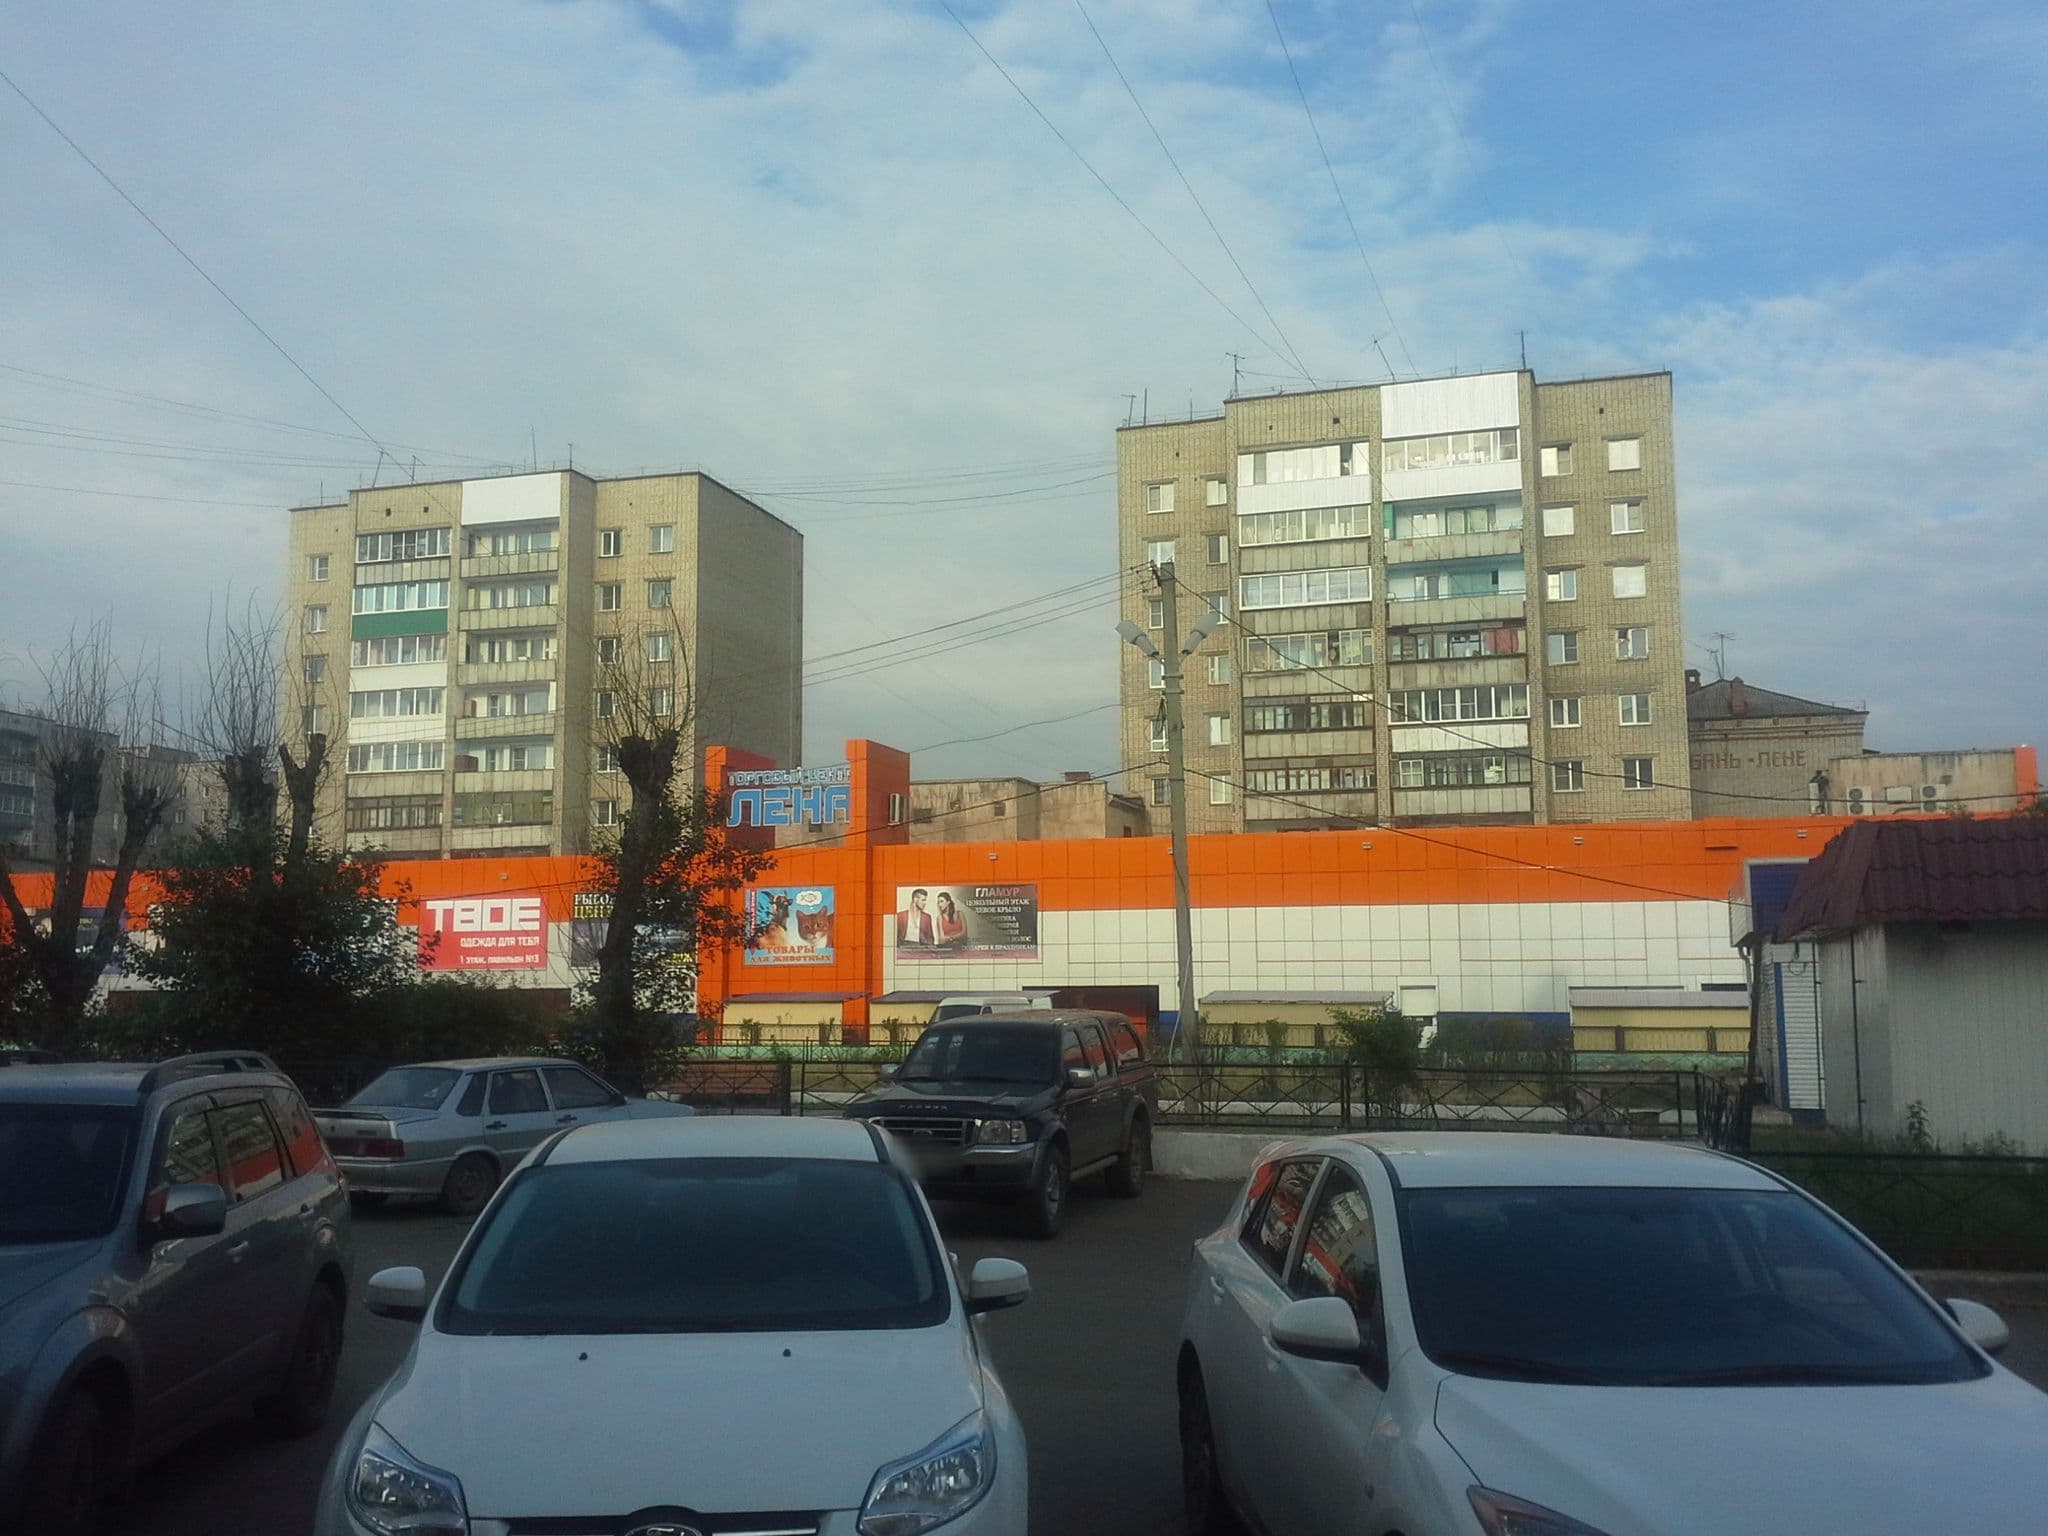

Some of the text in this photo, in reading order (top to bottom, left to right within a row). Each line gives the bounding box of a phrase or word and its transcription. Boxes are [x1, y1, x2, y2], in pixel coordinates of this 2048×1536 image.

[728, 766, 803, 786] ТОРГОВЫЙ
[727, 784, 851, 828] ЛЕНА
[975, 887, 1021, 898] ГЛАМУР
[426, 897, 541, 933] ТВОЕ
[460, 936, 540, 948] ОДЕЖДА ДЛЯ ТЕБЯ
[767, 945, 815, 954] ТОВАРЫ
